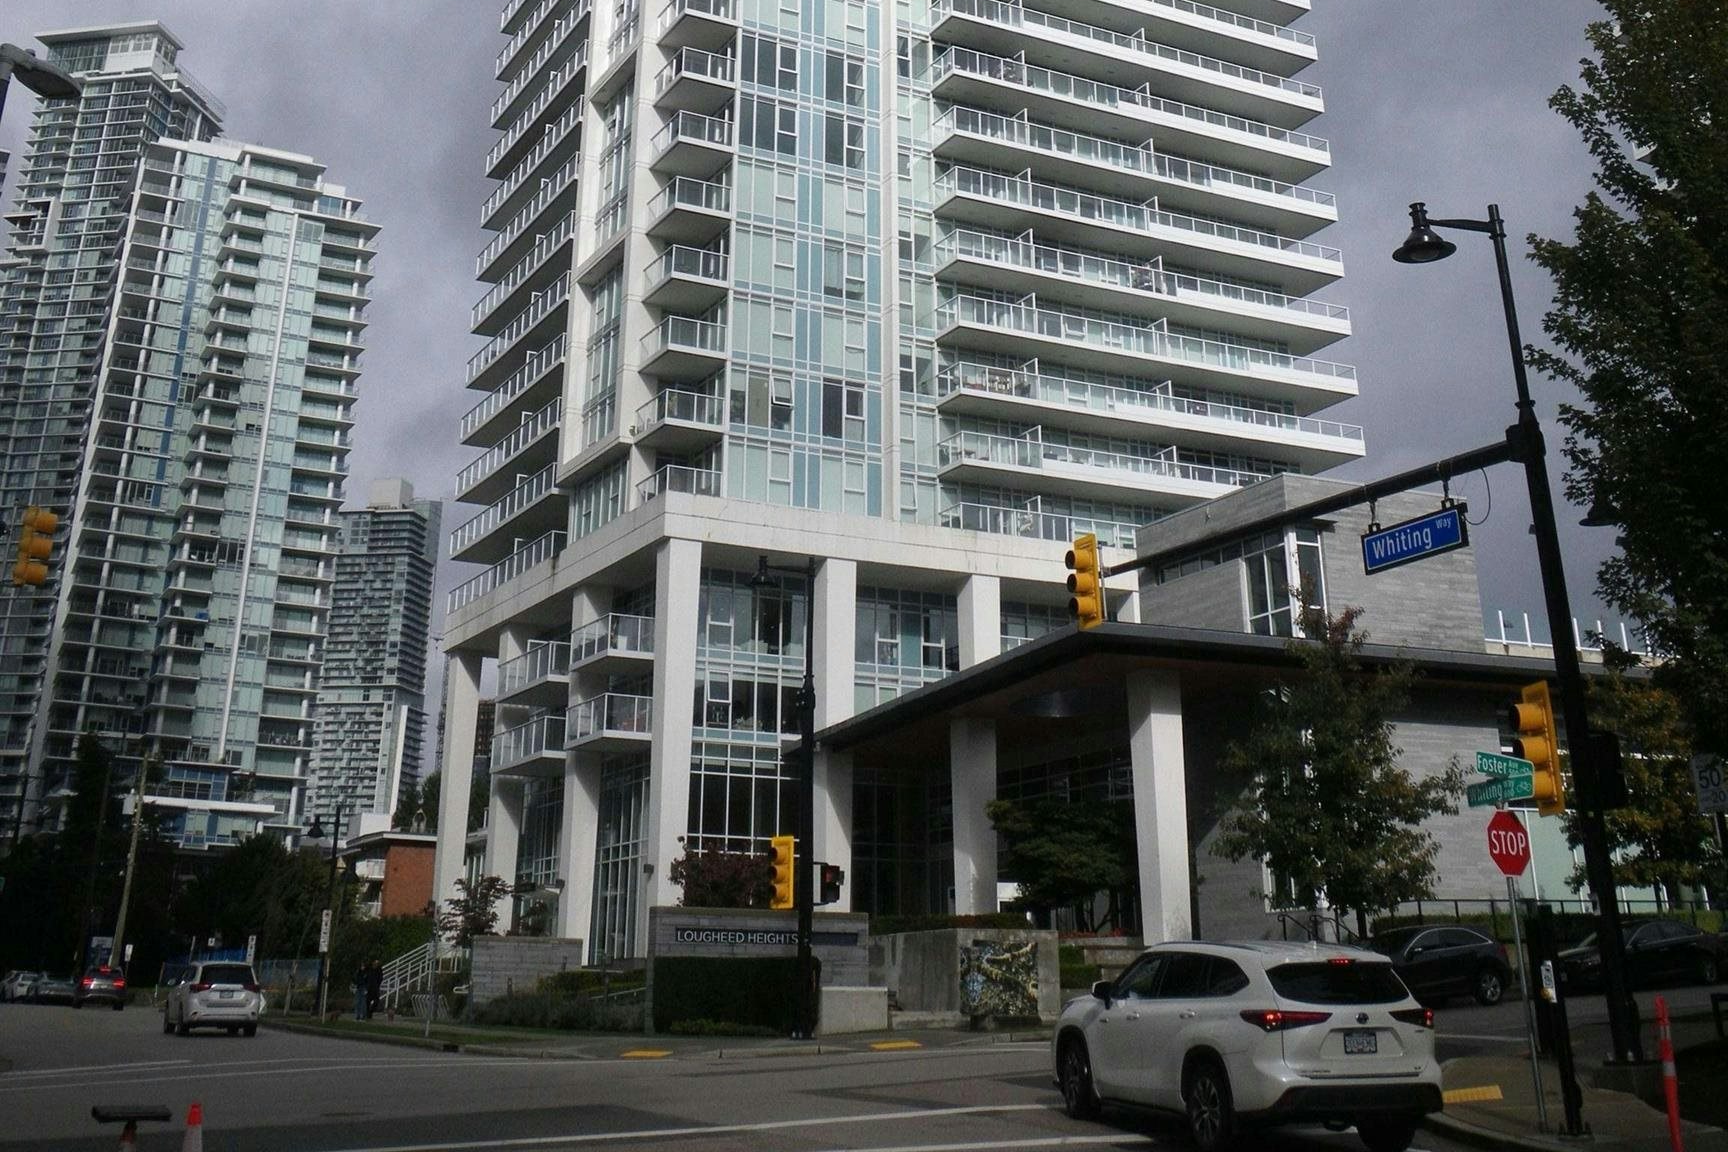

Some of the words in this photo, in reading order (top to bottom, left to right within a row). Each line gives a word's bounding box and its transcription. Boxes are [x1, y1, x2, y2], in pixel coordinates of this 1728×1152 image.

[1372, 528, 1432, 559] Whiting
[1435, 517, 1451, 529] Way
[1477, 754, 1507, 774] Foster
[1699, 769, 1720, 789] 50
[1491, 829, 1526, 857] STOP
[677, 930, 745, 944] LOUGHEED
[747, 932, 799, 945] HEIGHTS
